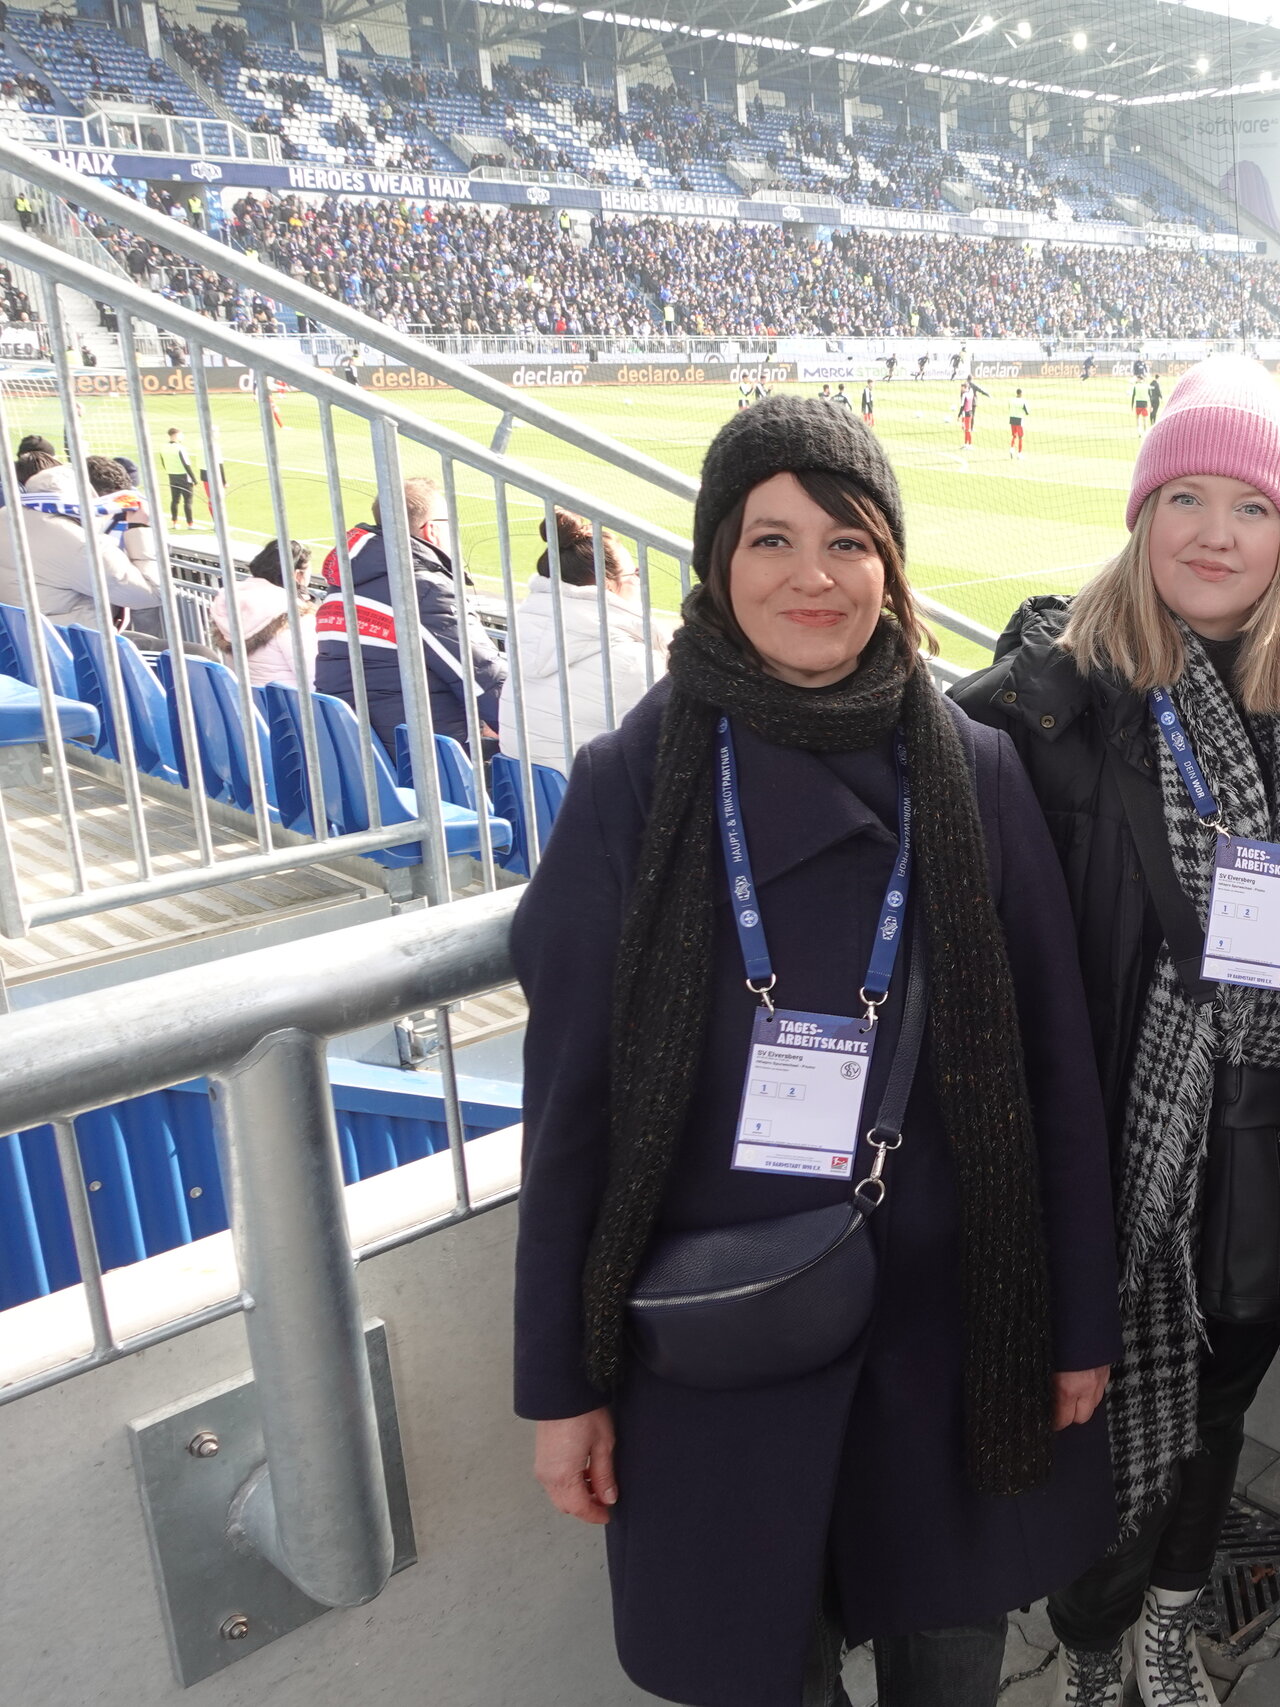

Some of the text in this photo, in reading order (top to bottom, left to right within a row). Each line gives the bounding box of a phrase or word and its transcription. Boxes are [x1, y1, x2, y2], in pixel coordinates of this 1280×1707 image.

[1196, 116, 1270, 135] software
[59, 150, 118, 176] HAIX
[288, 167, 472, 200] HEROES WEAR HAIX
[600, 191, 740, 217] HEROES WEAR HAIX
[841, 208, 950, 232] HEROES WEAR HAIX
[512, 364, 583, 385] declaro
[618, 365, 705, 384] declaro.de
[803, 366, 854, 378] MERCK
[974, 361, 1019, 378] declaro
[1183, 760, 1198, 781] DEIN
[720, 745, 744, 863] HAUPT- & TRIKOTPARTNER
[897, 796, 912, 878] WORKWEAR-PROFI
[1236, 846, 1271, 861] TAGES-
[1227, 874, 1256, 885] Elversberg
[779, 1019, 824, 1035] TAGES-
[776, 1032, 869, 1054] ARBEITSKARTE
[768, 1050, 804, 1062] Elversberg
[789, 1087, 795, 1095] 2
[756, 1122, 762, 1131] 9
